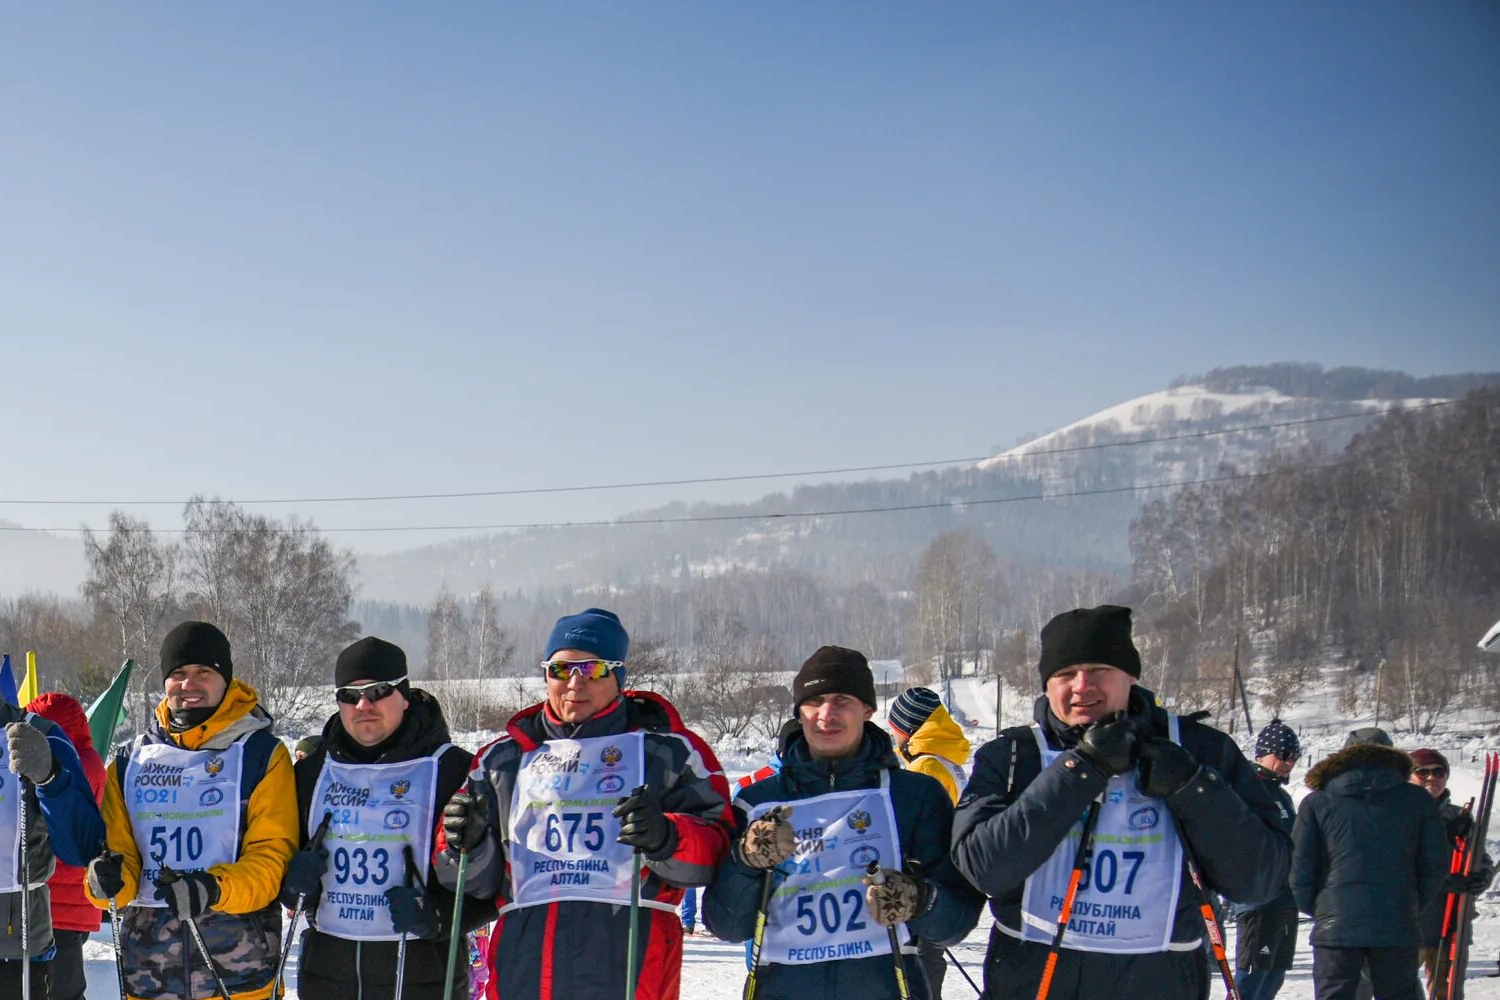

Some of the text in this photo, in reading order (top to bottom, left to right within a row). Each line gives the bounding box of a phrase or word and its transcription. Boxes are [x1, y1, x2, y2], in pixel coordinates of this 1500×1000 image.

[134, 774, 182, 787] РОССИИ
[135, 788, 177, 804] 2021
[20, 799, 28, 852] NORDWAY
[545, 812, 605, 853] 675
[150, 826, 203, 863] 510
[334, 847, 390, 886] 933
[534, 859, 610, 873] РЕСПУБЛИКА
[339, 907, 375, 921] АЛТАЙ
[796, 889, 867, 936] 502
[1066, 919, 1116, 936] АЛТАЙ
[788, 940, 873, 961] РЕСПУБЛИКА
